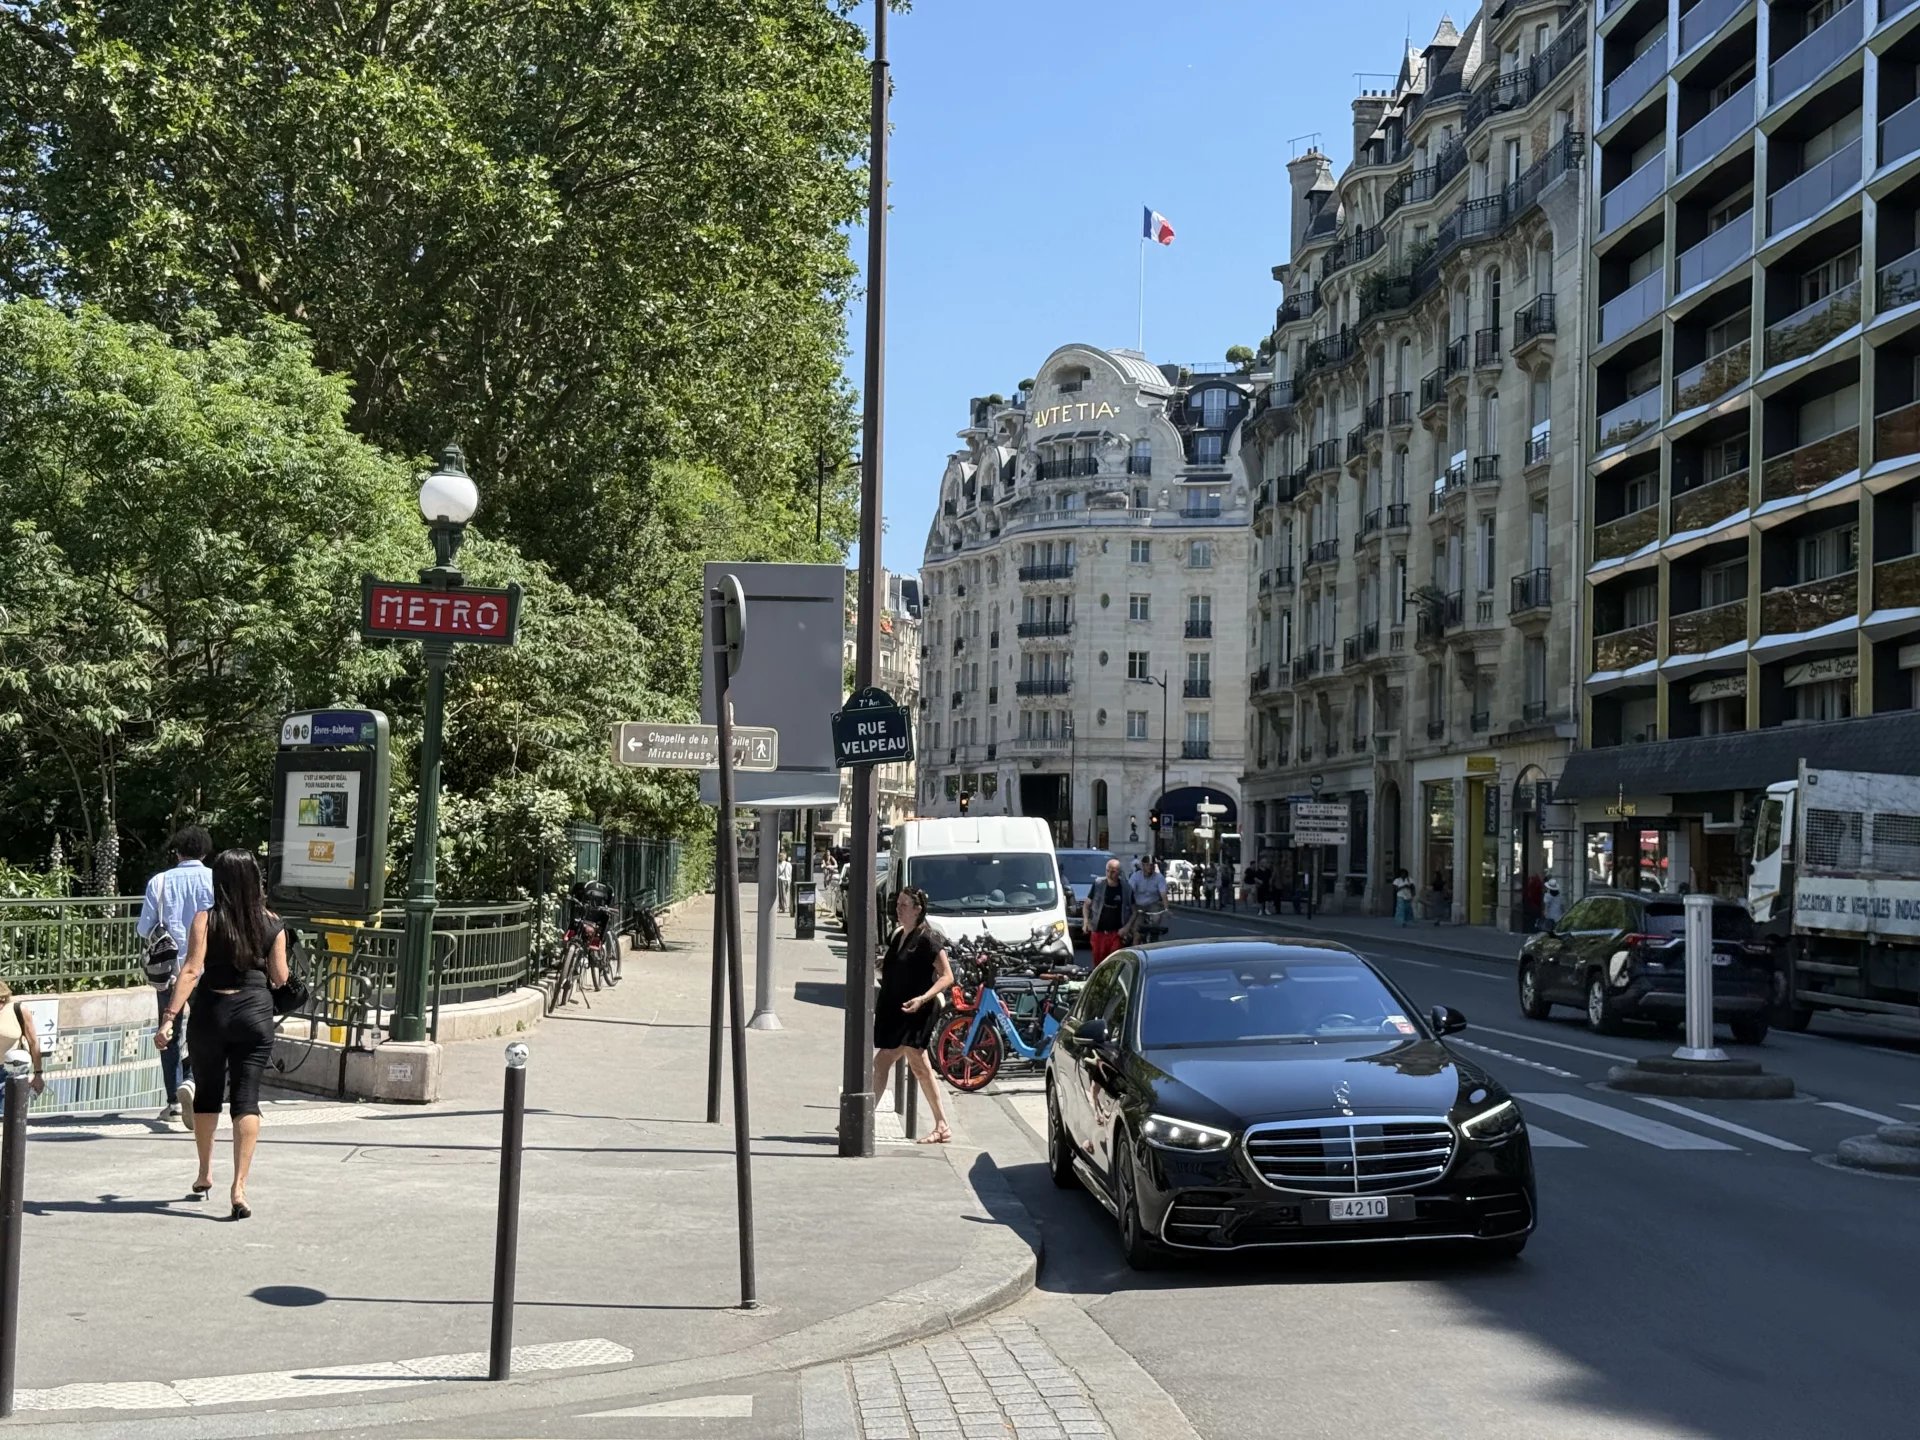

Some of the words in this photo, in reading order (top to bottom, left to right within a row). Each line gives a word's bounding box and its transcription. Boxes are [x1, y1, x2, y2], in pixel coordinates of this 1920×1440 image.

[379, 595, 499, 630] METRO
[857, 721, 887, 735] RUE
[648, 732, 686, 745] Chapelle
[688, 735, 699, 744] de
[701, 734, 708, 744] la
[842, 736, 906, 755] VELPEAU
